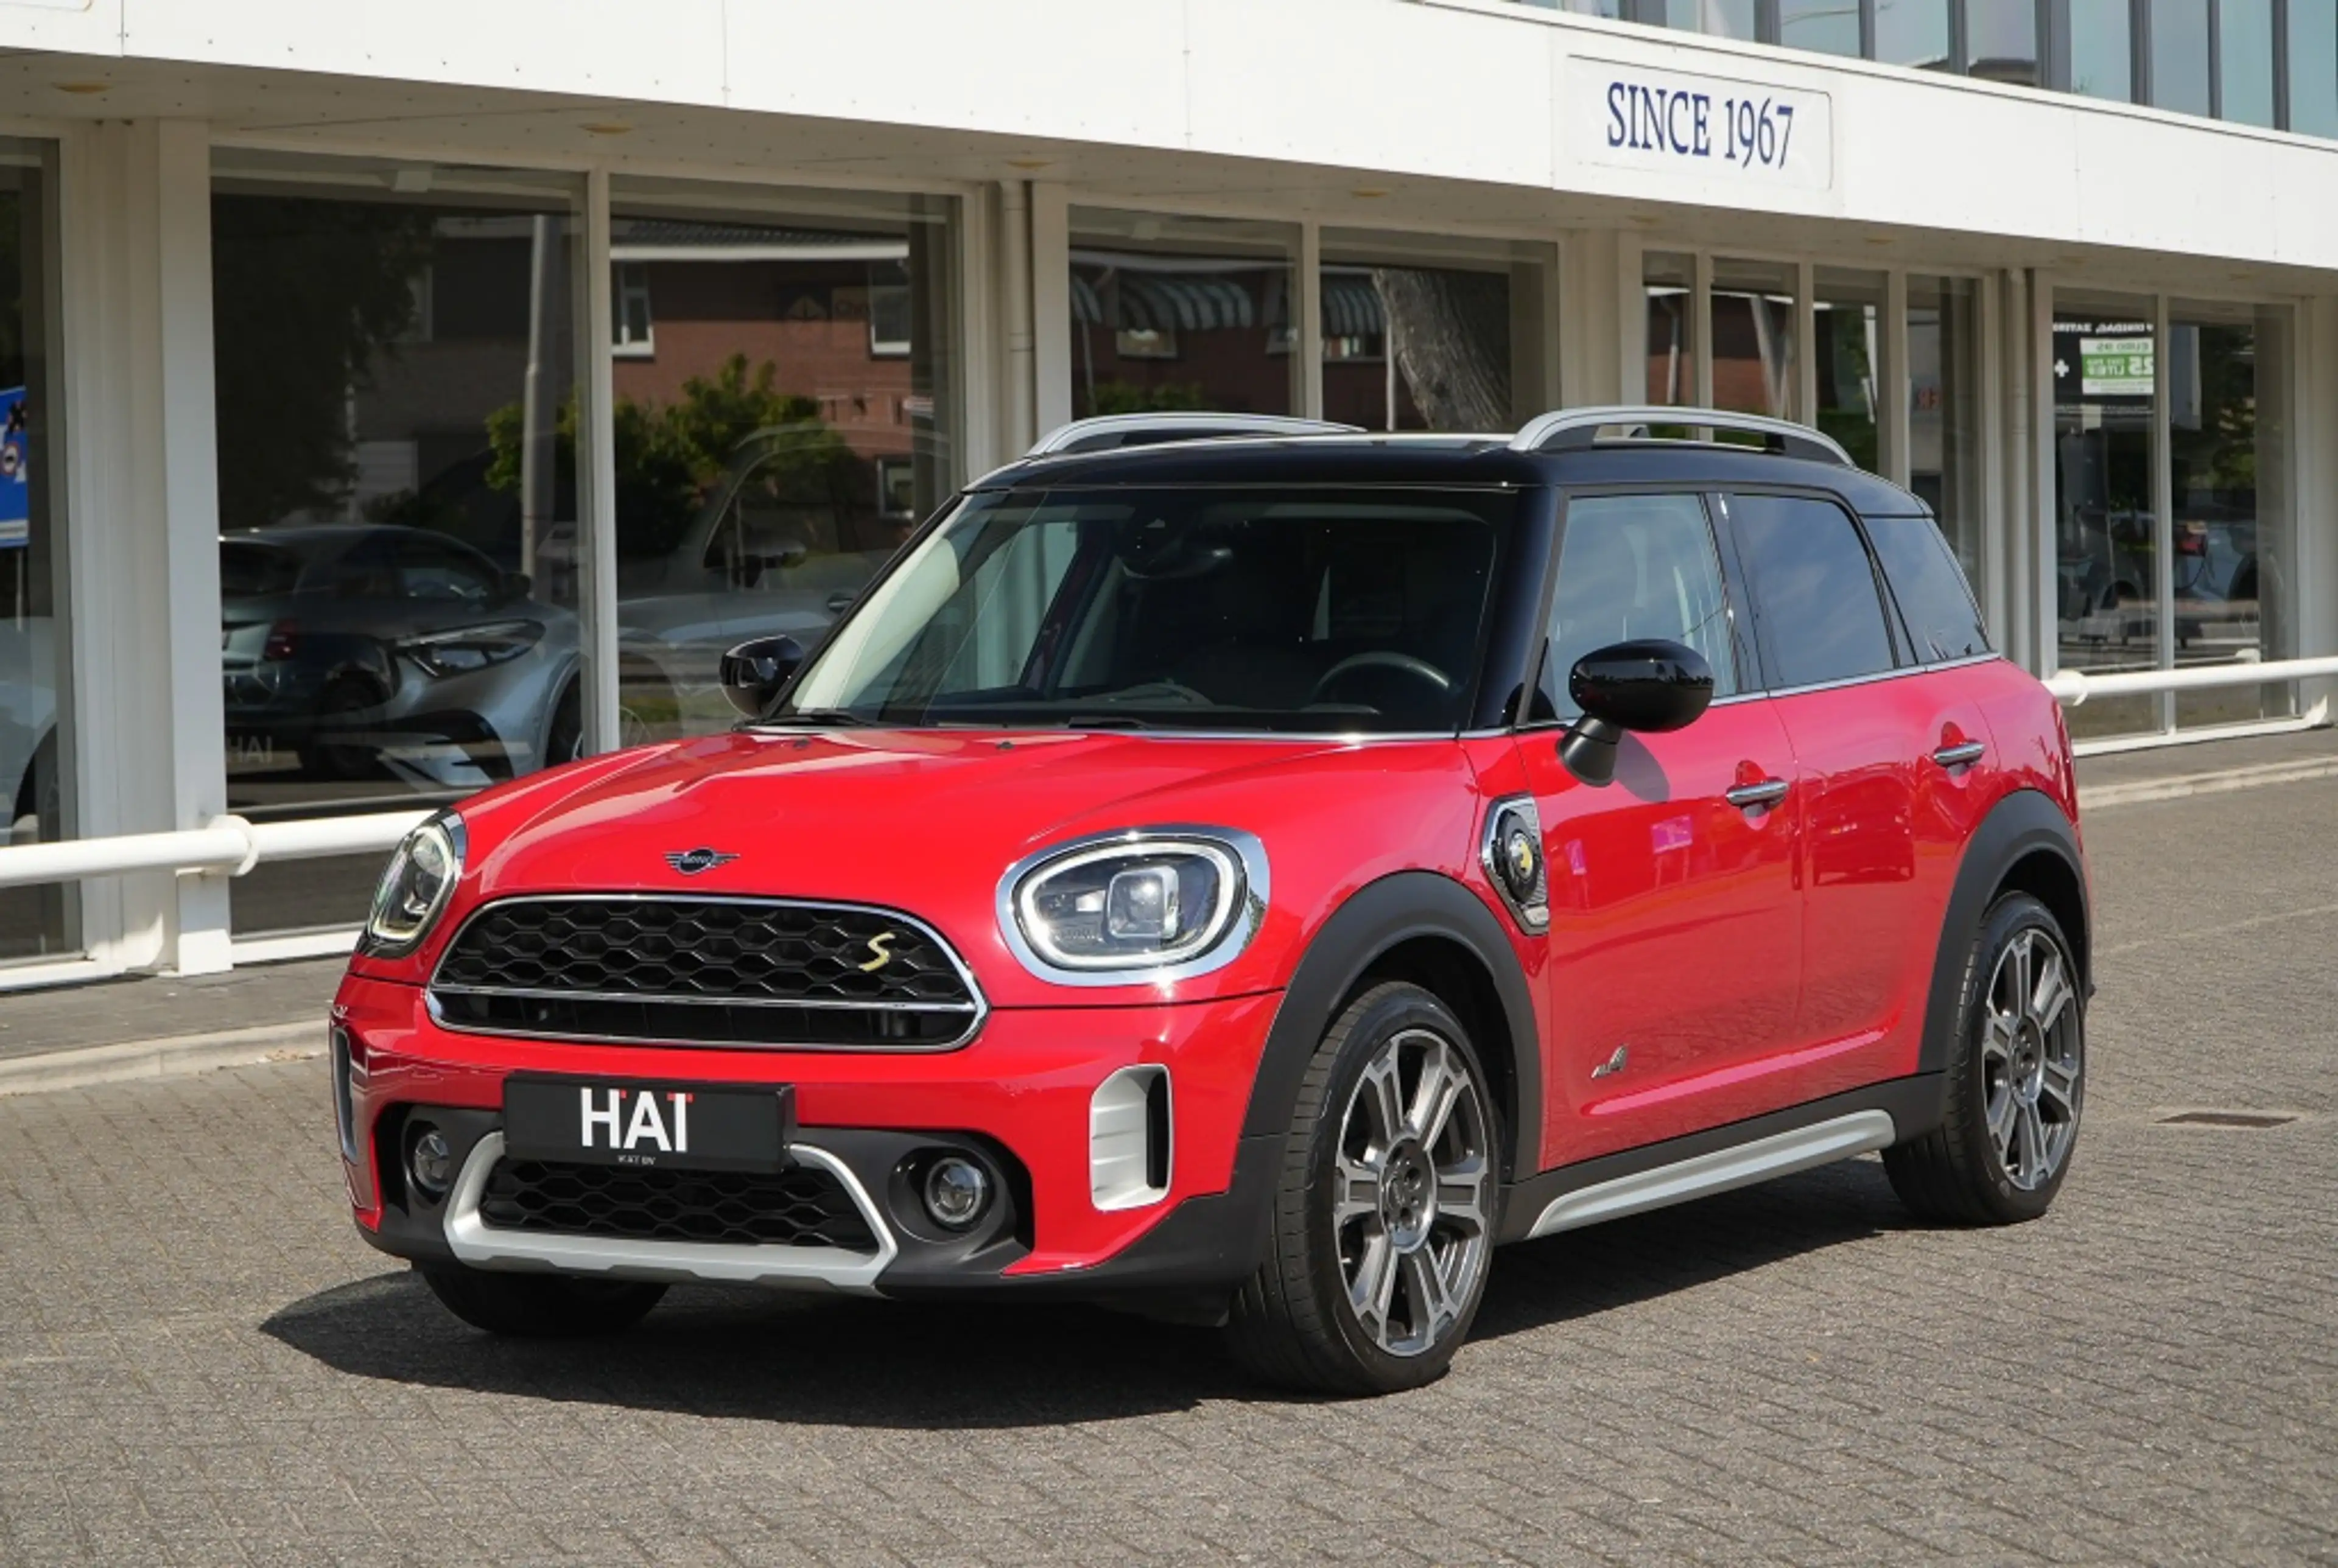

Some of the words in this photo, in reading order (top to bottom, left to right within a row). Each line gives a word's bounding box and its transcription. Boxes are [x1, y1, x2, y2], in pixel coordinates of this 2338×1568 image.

[1607, 82, 1711, 157] SINCE
[1724, 96, 1794, 170] 1967
[858, 931, 896, 972] S
[580, 1087, 694, 1152] HAT
